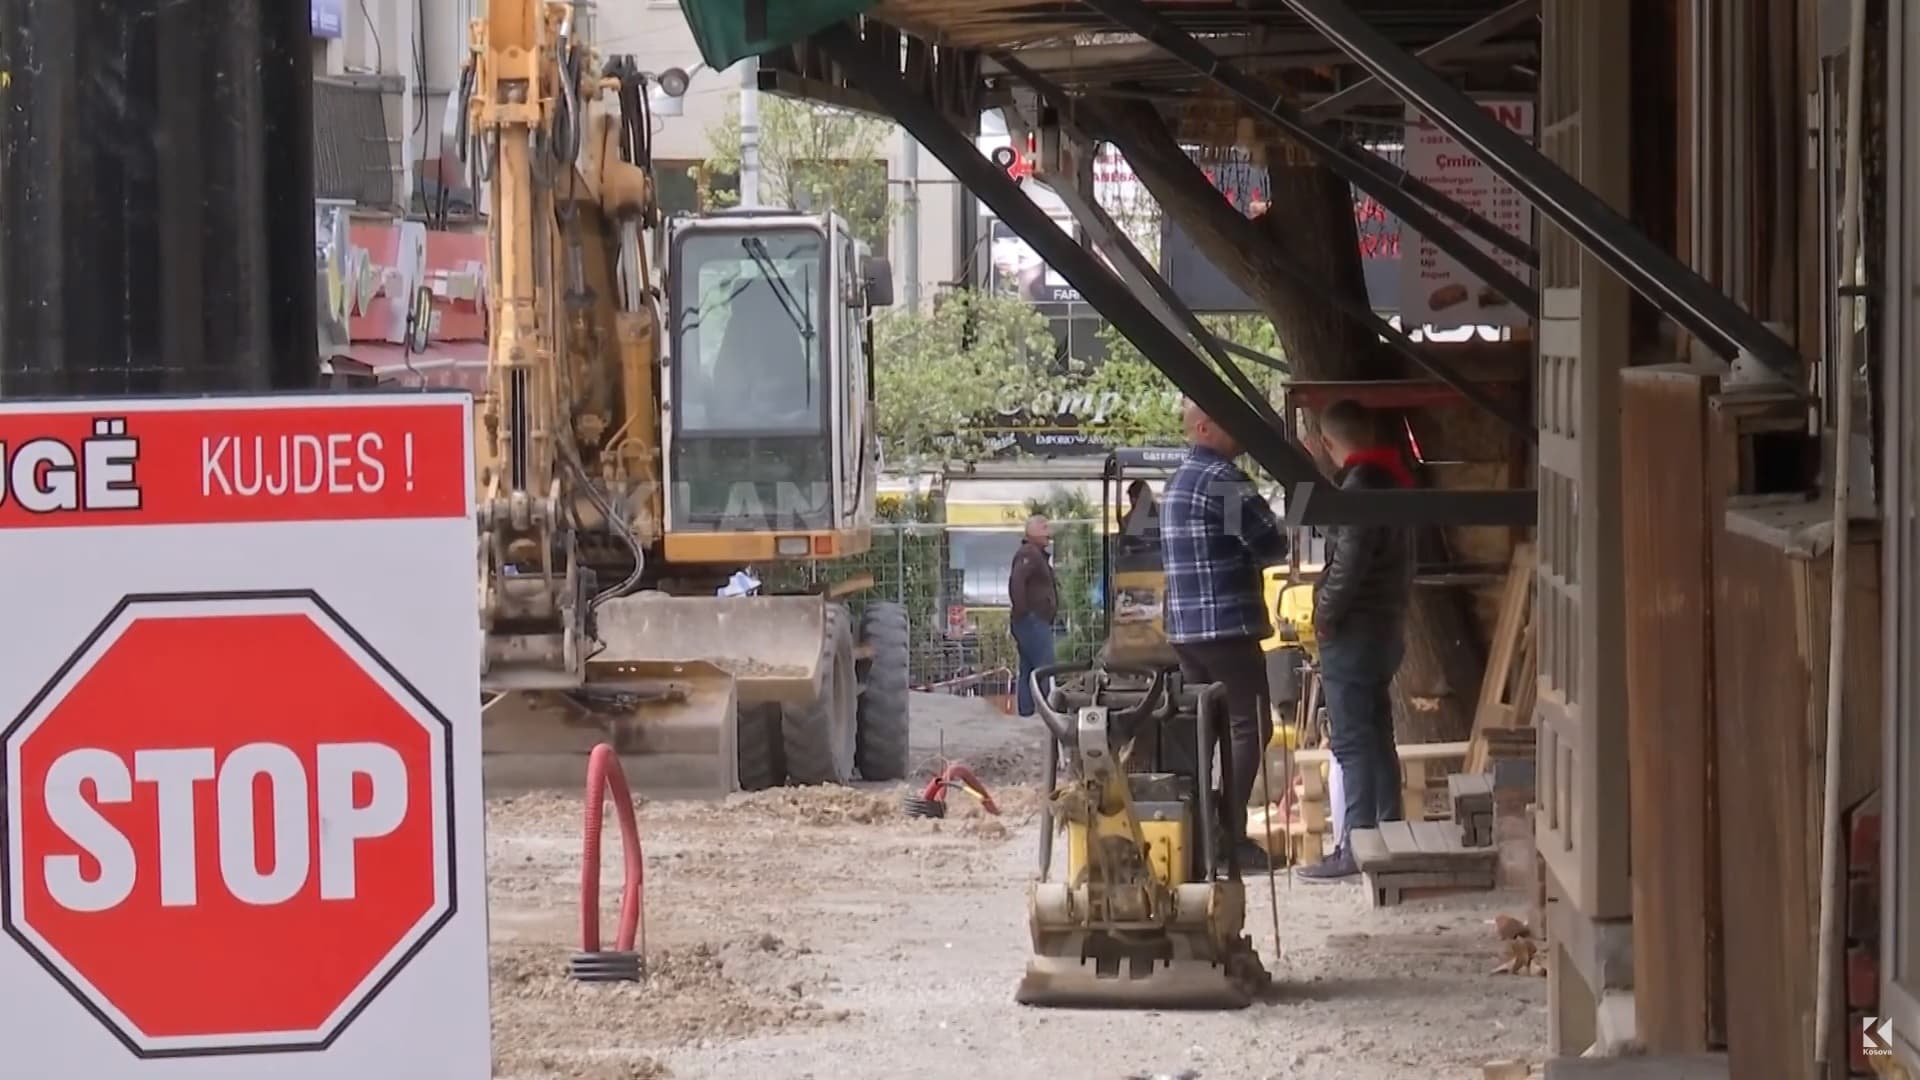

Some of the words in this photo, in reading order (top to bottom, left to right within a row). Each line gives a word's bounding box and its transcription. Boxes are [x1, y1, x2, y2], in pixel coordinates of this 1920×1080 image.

[0, 416, 143, 514] GË
[201, 432, 385, 497] KUJDES
[43, 741, 409, 912] STOP
